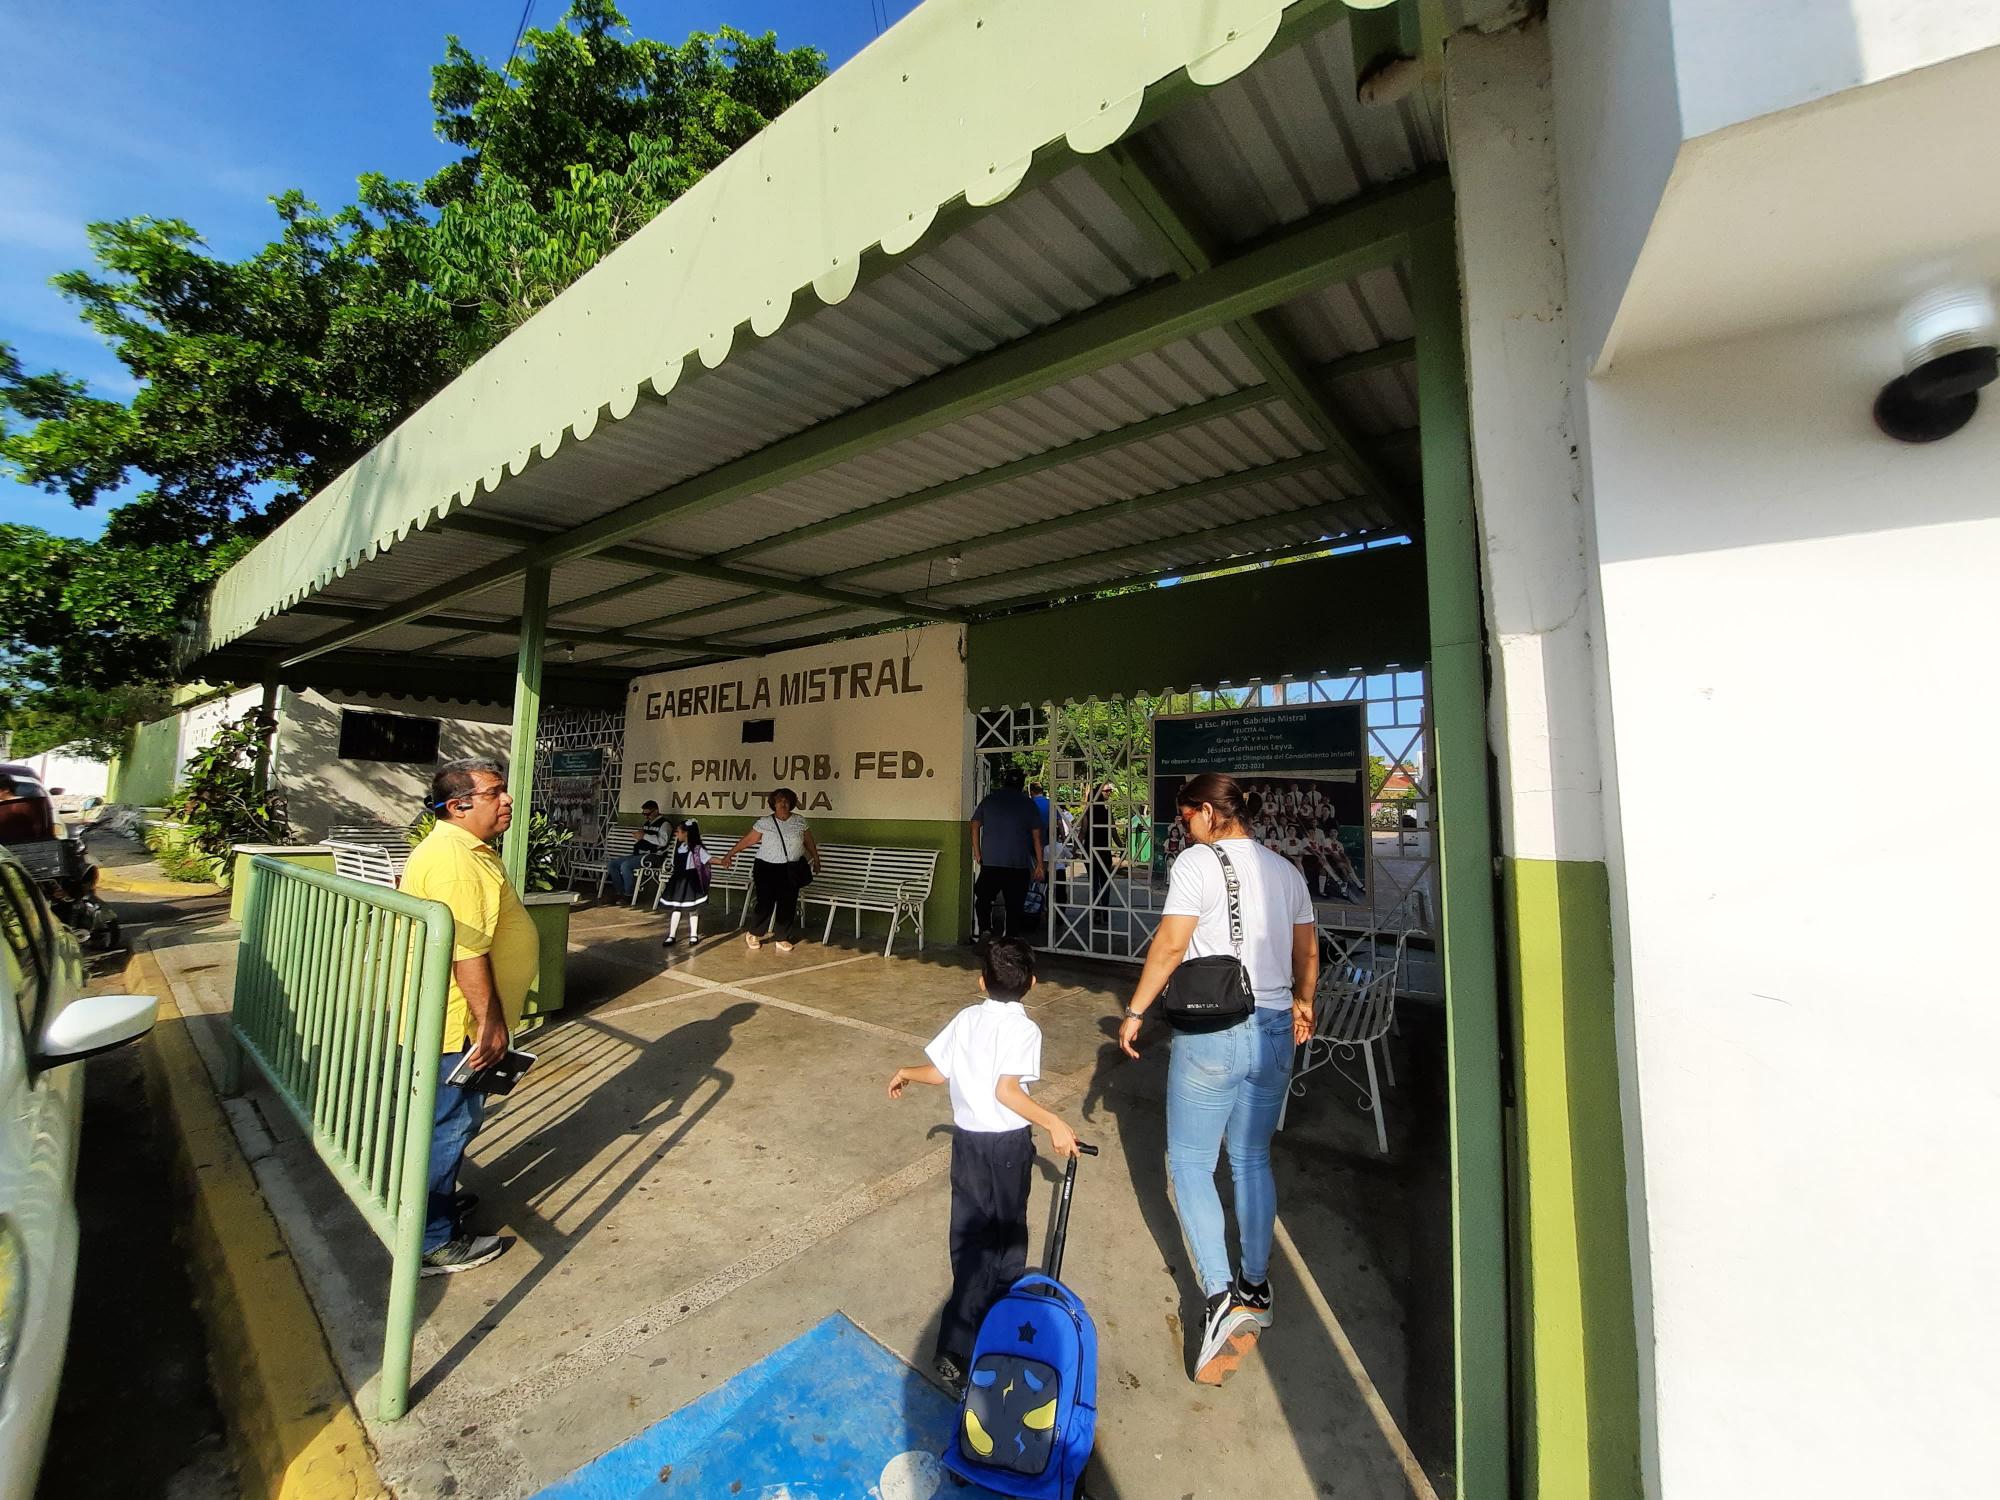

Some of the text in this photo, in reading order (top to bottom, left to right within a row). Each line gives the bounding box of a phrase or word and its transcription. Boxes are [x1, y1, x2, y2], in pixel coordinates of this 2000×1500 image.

[645, 656, 923, 720] GABRIELA MISTRAL
[1243, 716, 1276, 725] Gabriela
[1278, 713, 1307, 722] Mistral
[633, 750, 935, 784] ESC. PRIM. URB. FED.
[671, 791, 833, 811] MATUTNA
